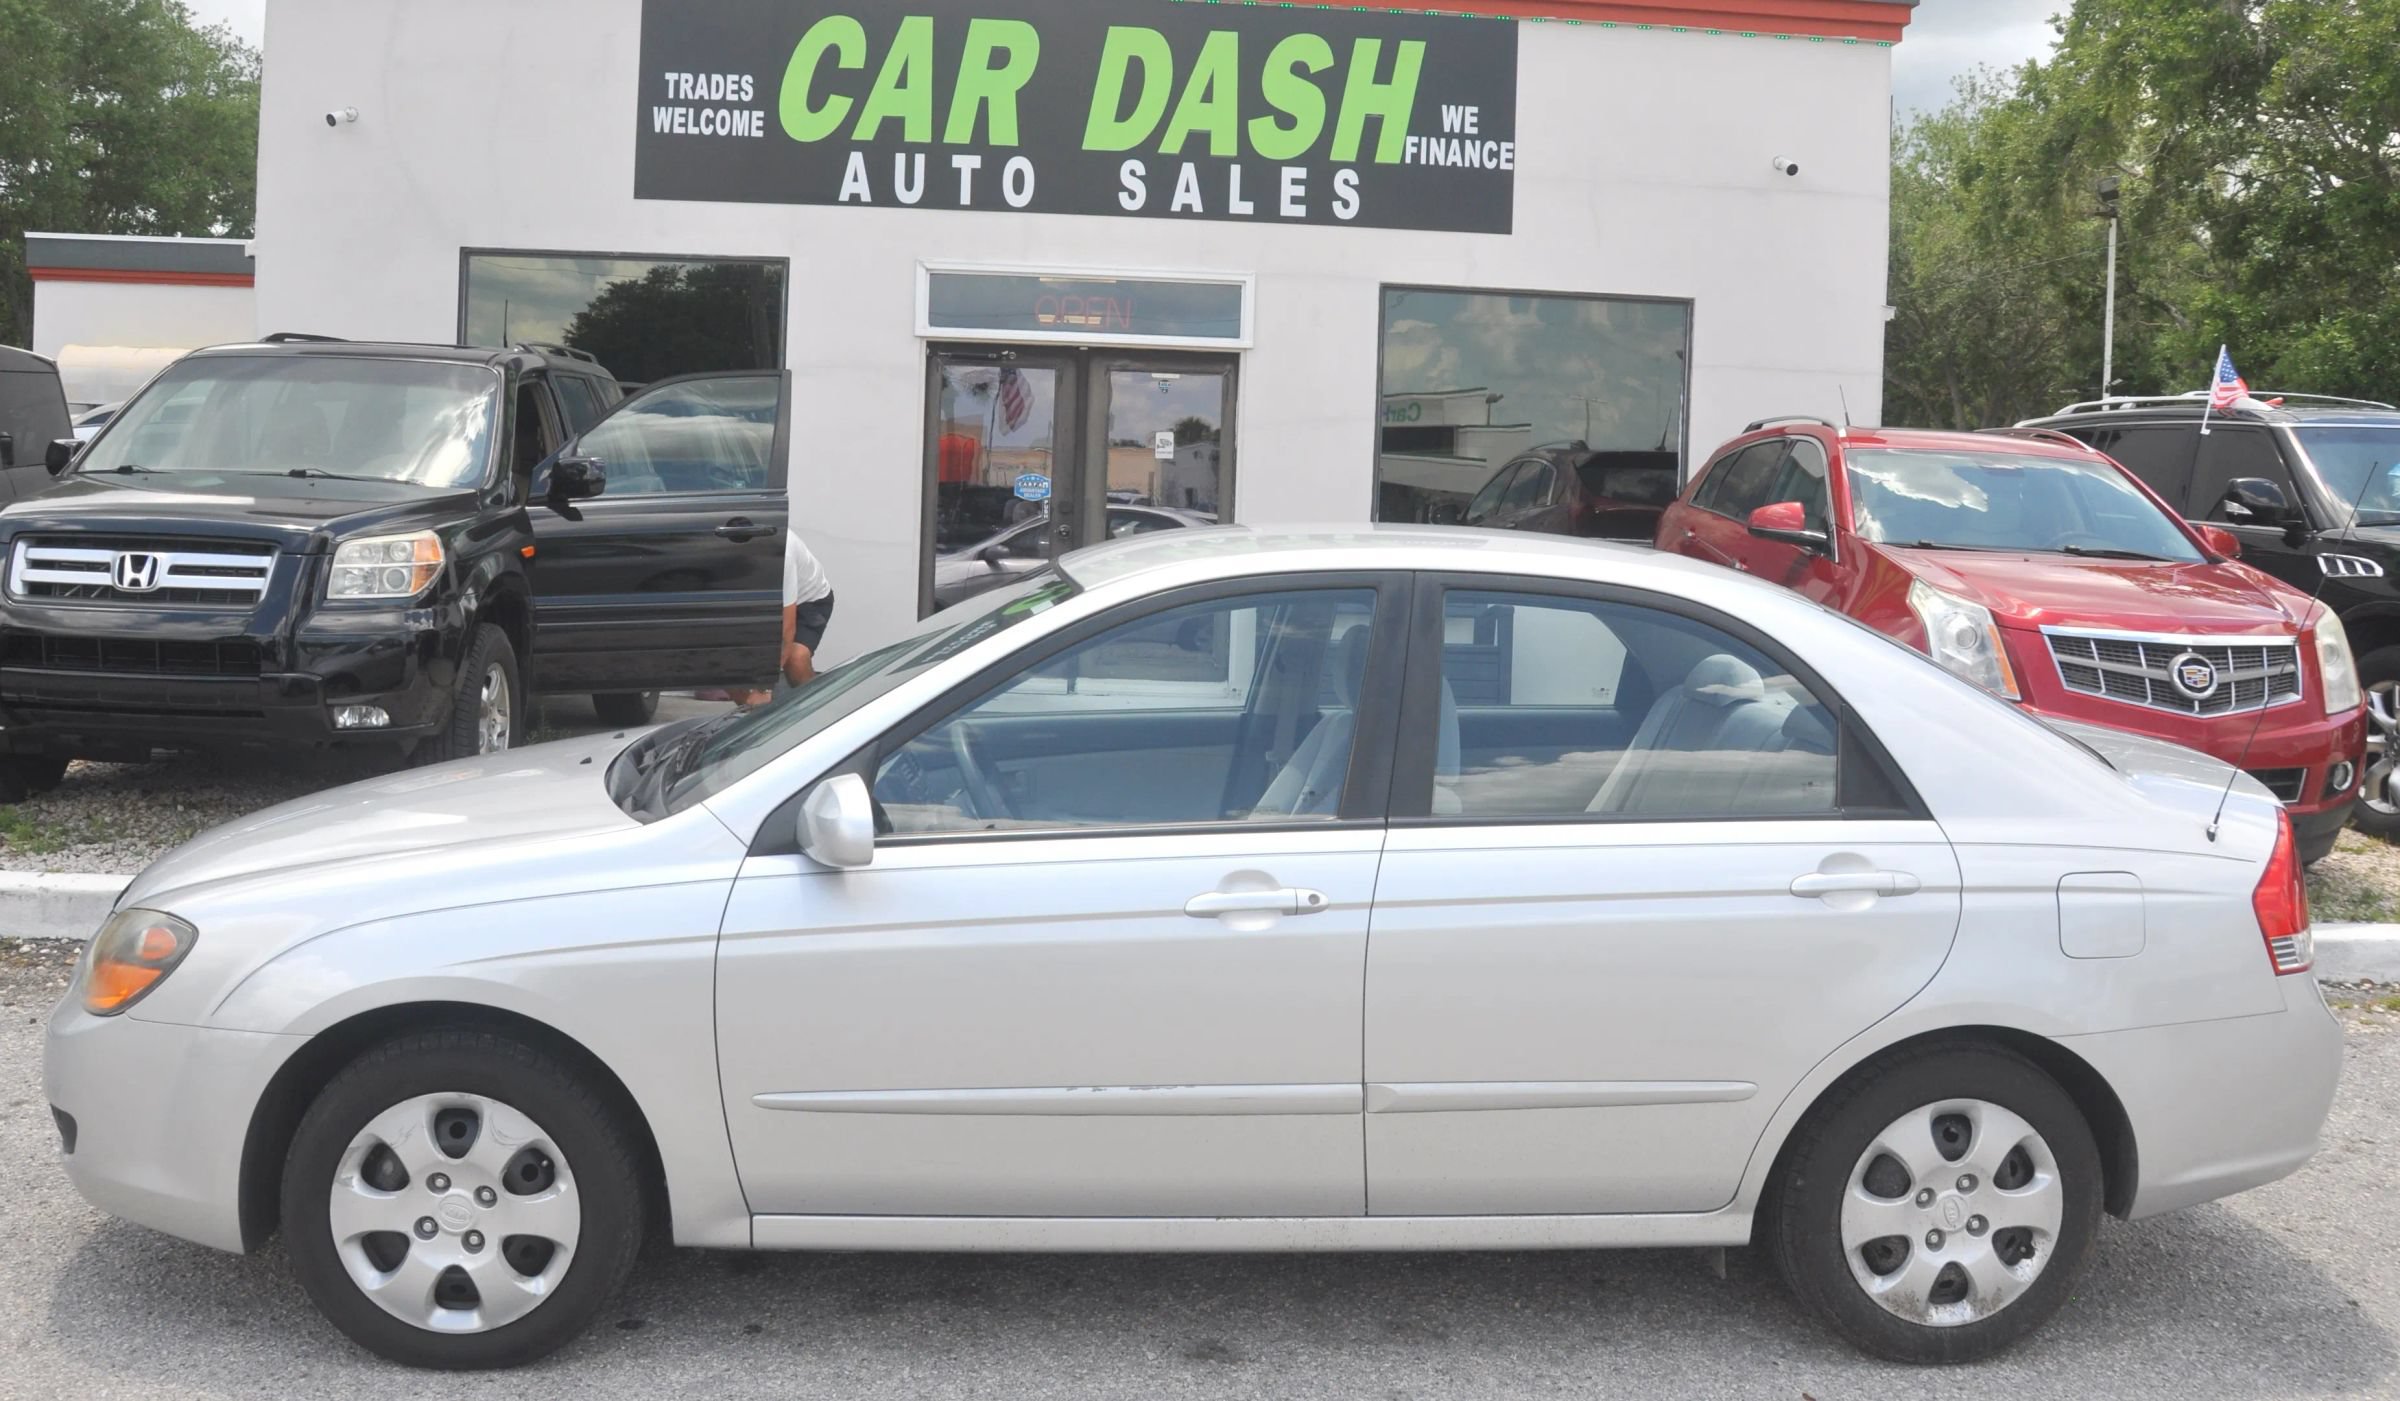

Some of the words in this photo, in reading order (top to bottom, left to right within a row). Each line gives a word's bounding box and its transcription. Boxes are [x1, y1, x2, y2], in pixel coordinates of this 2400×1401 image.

[664, 72, 754, 102] TRADES
[779, 15, 1040, 146] CAR
[1082, 26, 1427, 164] DASH
[652, 106, 765, 137] WELCOME
[1441, 104, 1479, 134] WE
[1404, 135, 1514, 170] FINANCE
[838, 151, 1035, 208] AUTO
[1118, 159, 1360, 220] SALES
[1034, 295, 1132, 328] OPEN
[1018, 481, 1049, 489] CARFA
